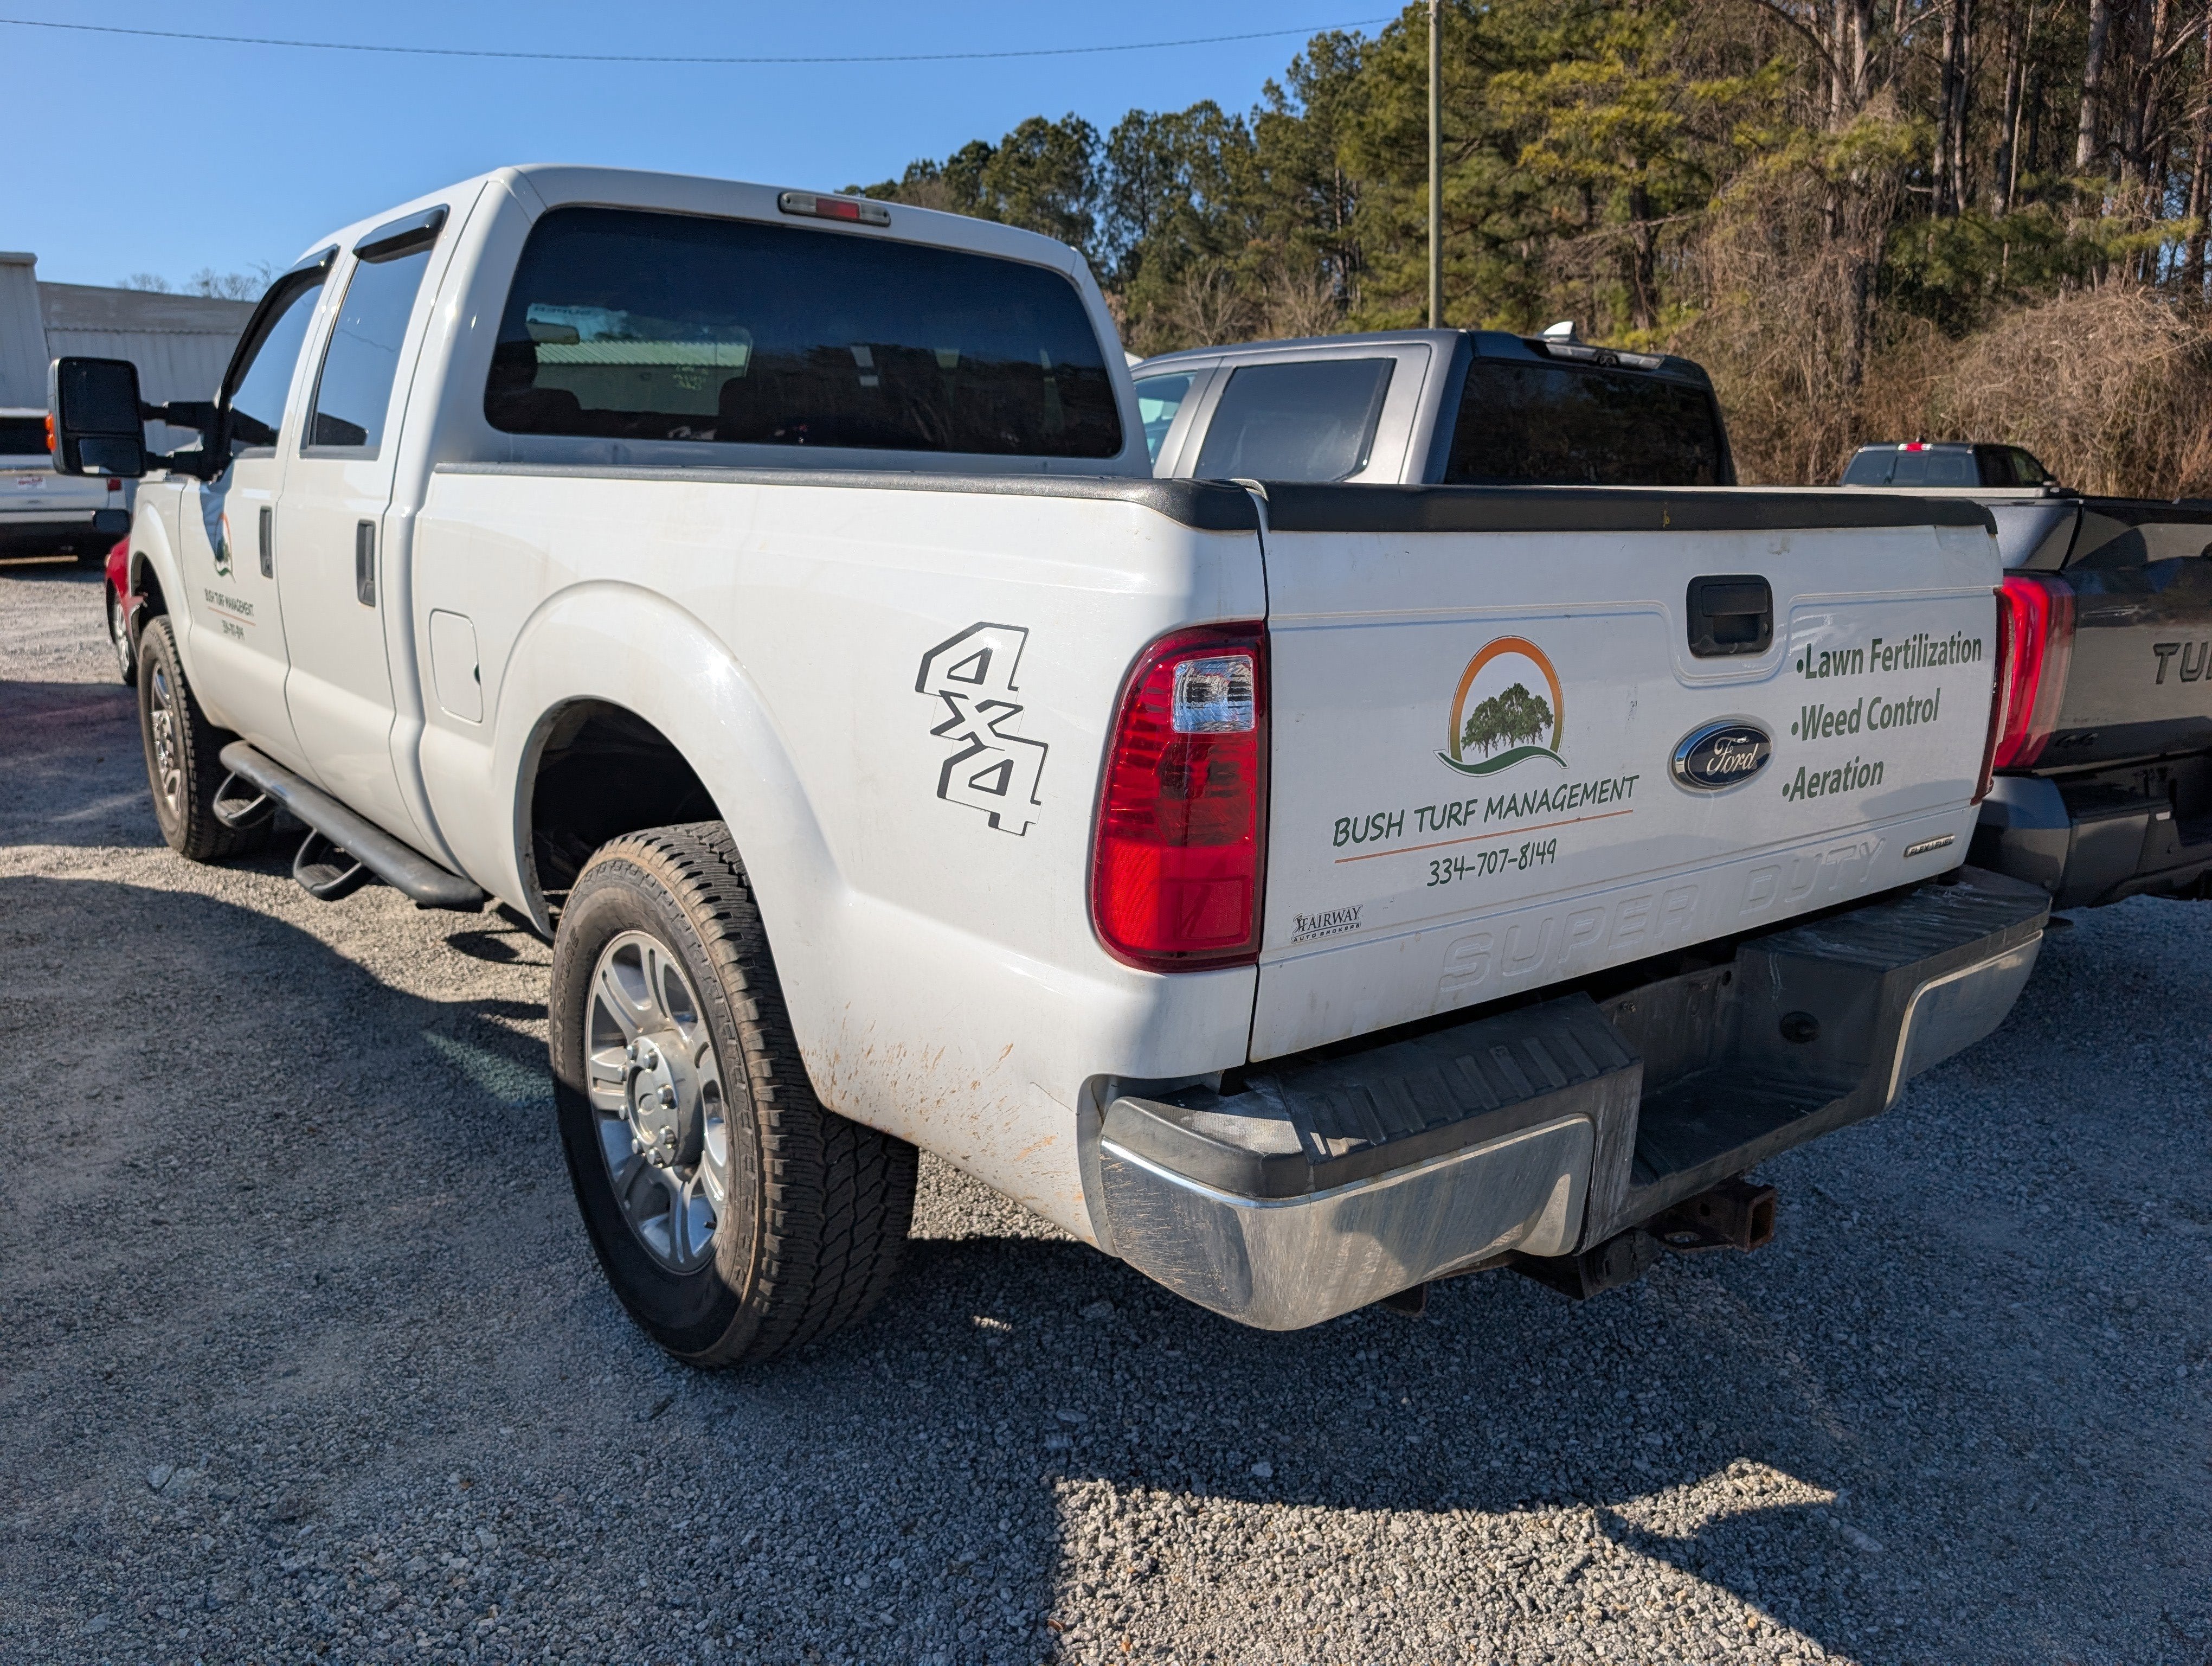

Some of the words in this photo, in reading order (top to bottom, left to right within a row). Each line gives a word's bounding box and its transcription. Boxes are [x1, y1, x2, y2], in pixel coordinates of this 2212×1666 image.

[1805, 643, 1864, 680] Lawn
[1869, 630, 1982, 673] Fertilization
[2153, 641, 2212, 684] TU
[1801, 697, 1863, 741] Weed
[1867, 687, 1941, 731] Control
[1706, 736, 1759, 776] Ford
[1788, 755, 1884, 803] Aeration
[1332, 809, 1406, 847] BUSH
[1413, 798, 1479, 833] TURF
[1483, 774, 1641, 823] MANAGEMENT
[1426, 837, 1558, 887] 334-707-8149
[1293, 933, 1317, 943] AUTO
[1320, 924, 1360, 936] BROKERS
[1301, 906, 1362, 932] FAIRWAY
[1440, 883, 1701, 992] SUPER
[1739, 836, 1887, 915] DUTY
